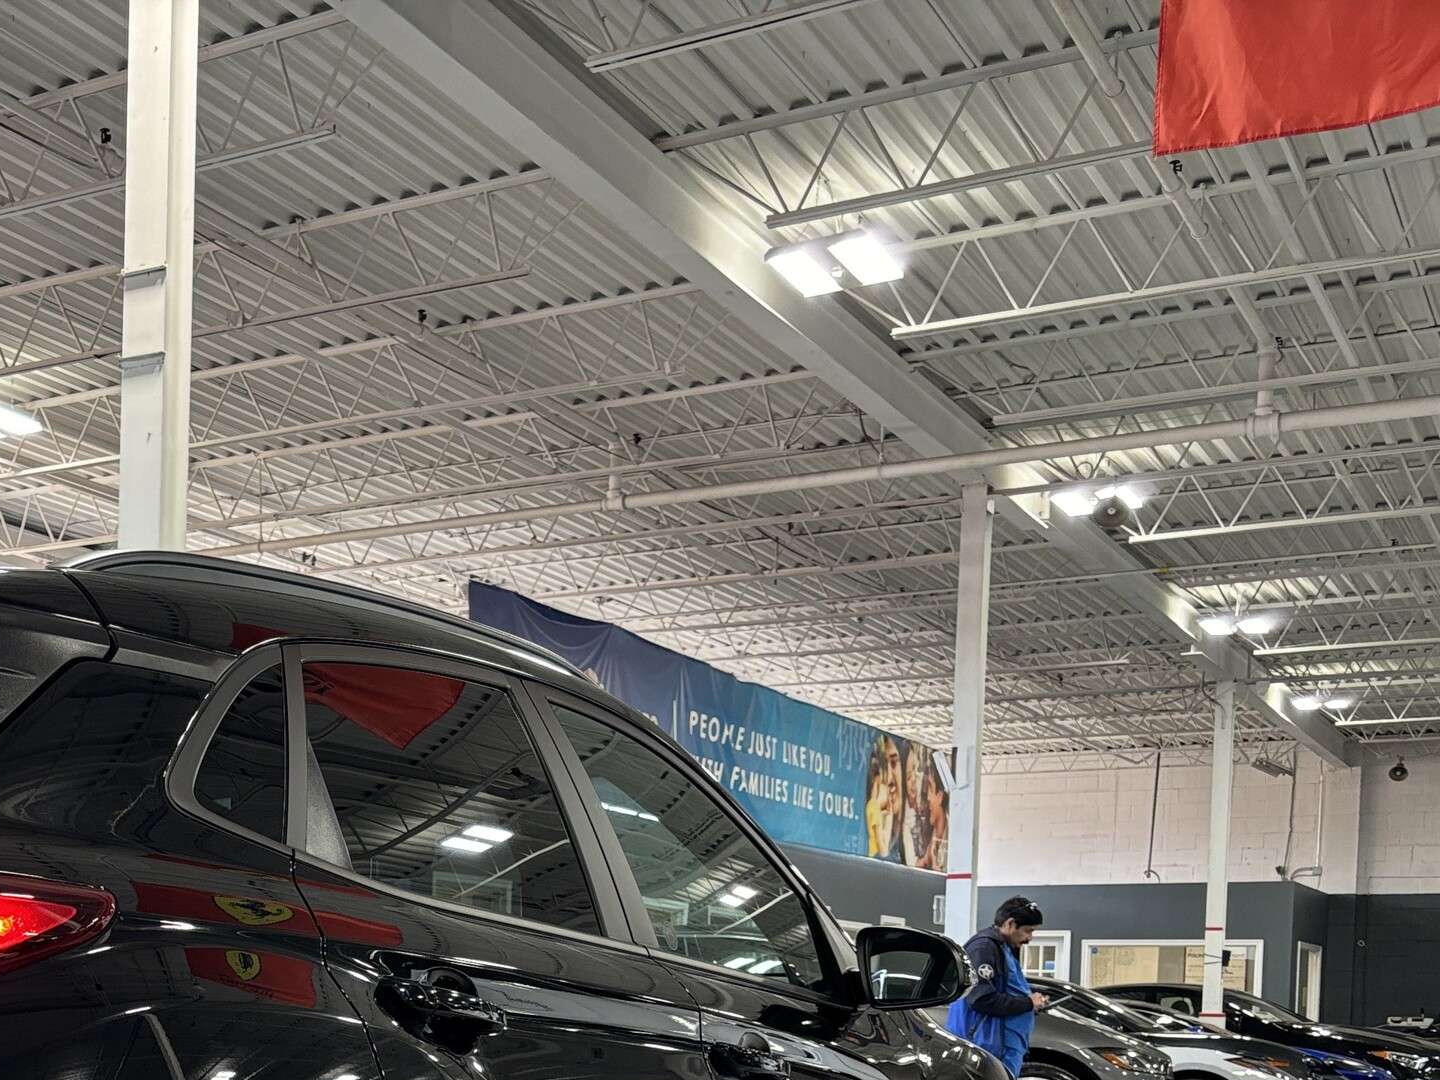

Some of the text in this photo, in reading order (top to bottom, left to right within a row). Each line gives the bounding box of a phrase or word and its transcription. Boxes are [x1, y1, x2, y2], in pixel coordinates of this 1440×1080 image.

[747, 731, 778, 760] JUST
[782, 741, 807, 769] LIKE
[808, 749, 835, 780] YOU,
[729, 766, 789, 804] FAMILIES
[793, 783, 814, 811] LIKE
[818, 791, 859, 820] YOURS.
